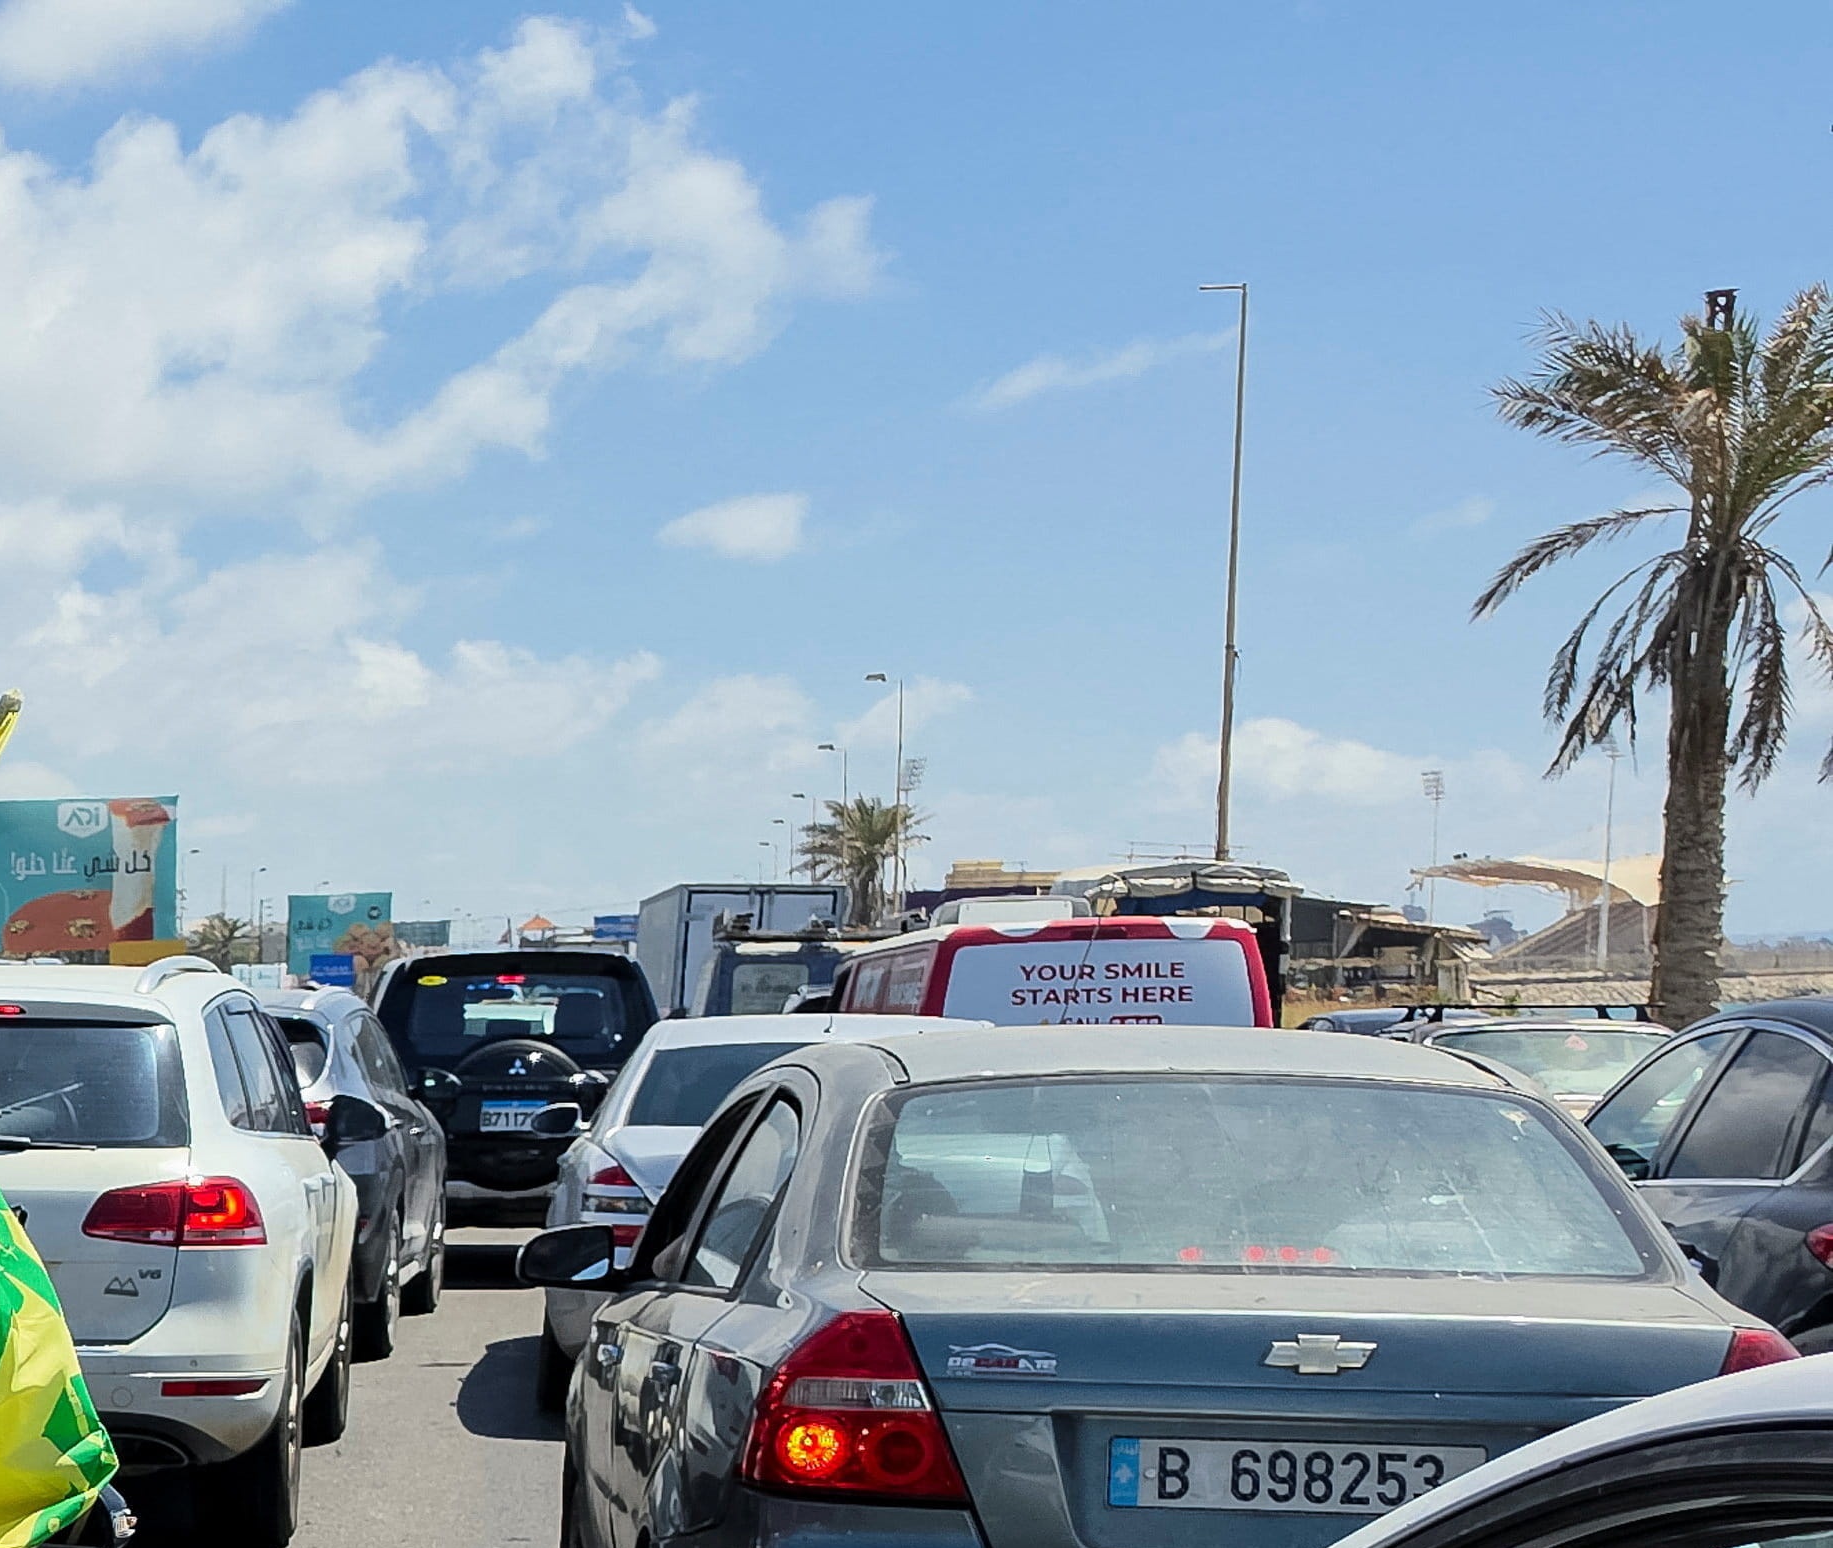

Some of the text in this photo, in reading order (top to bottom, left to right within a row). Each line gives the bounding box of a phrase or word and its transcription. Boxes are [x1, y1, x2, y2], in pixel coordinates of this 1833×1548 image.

[124, 850, 151, 874] كل
[1020, 962, 1185, 981] YOUR SMILE
[1011, 985, 1193, 1006] STARTS HERE
[138, 1269, 162, 1279] V6
[1230, 1449, 1445, 1506] 698253
